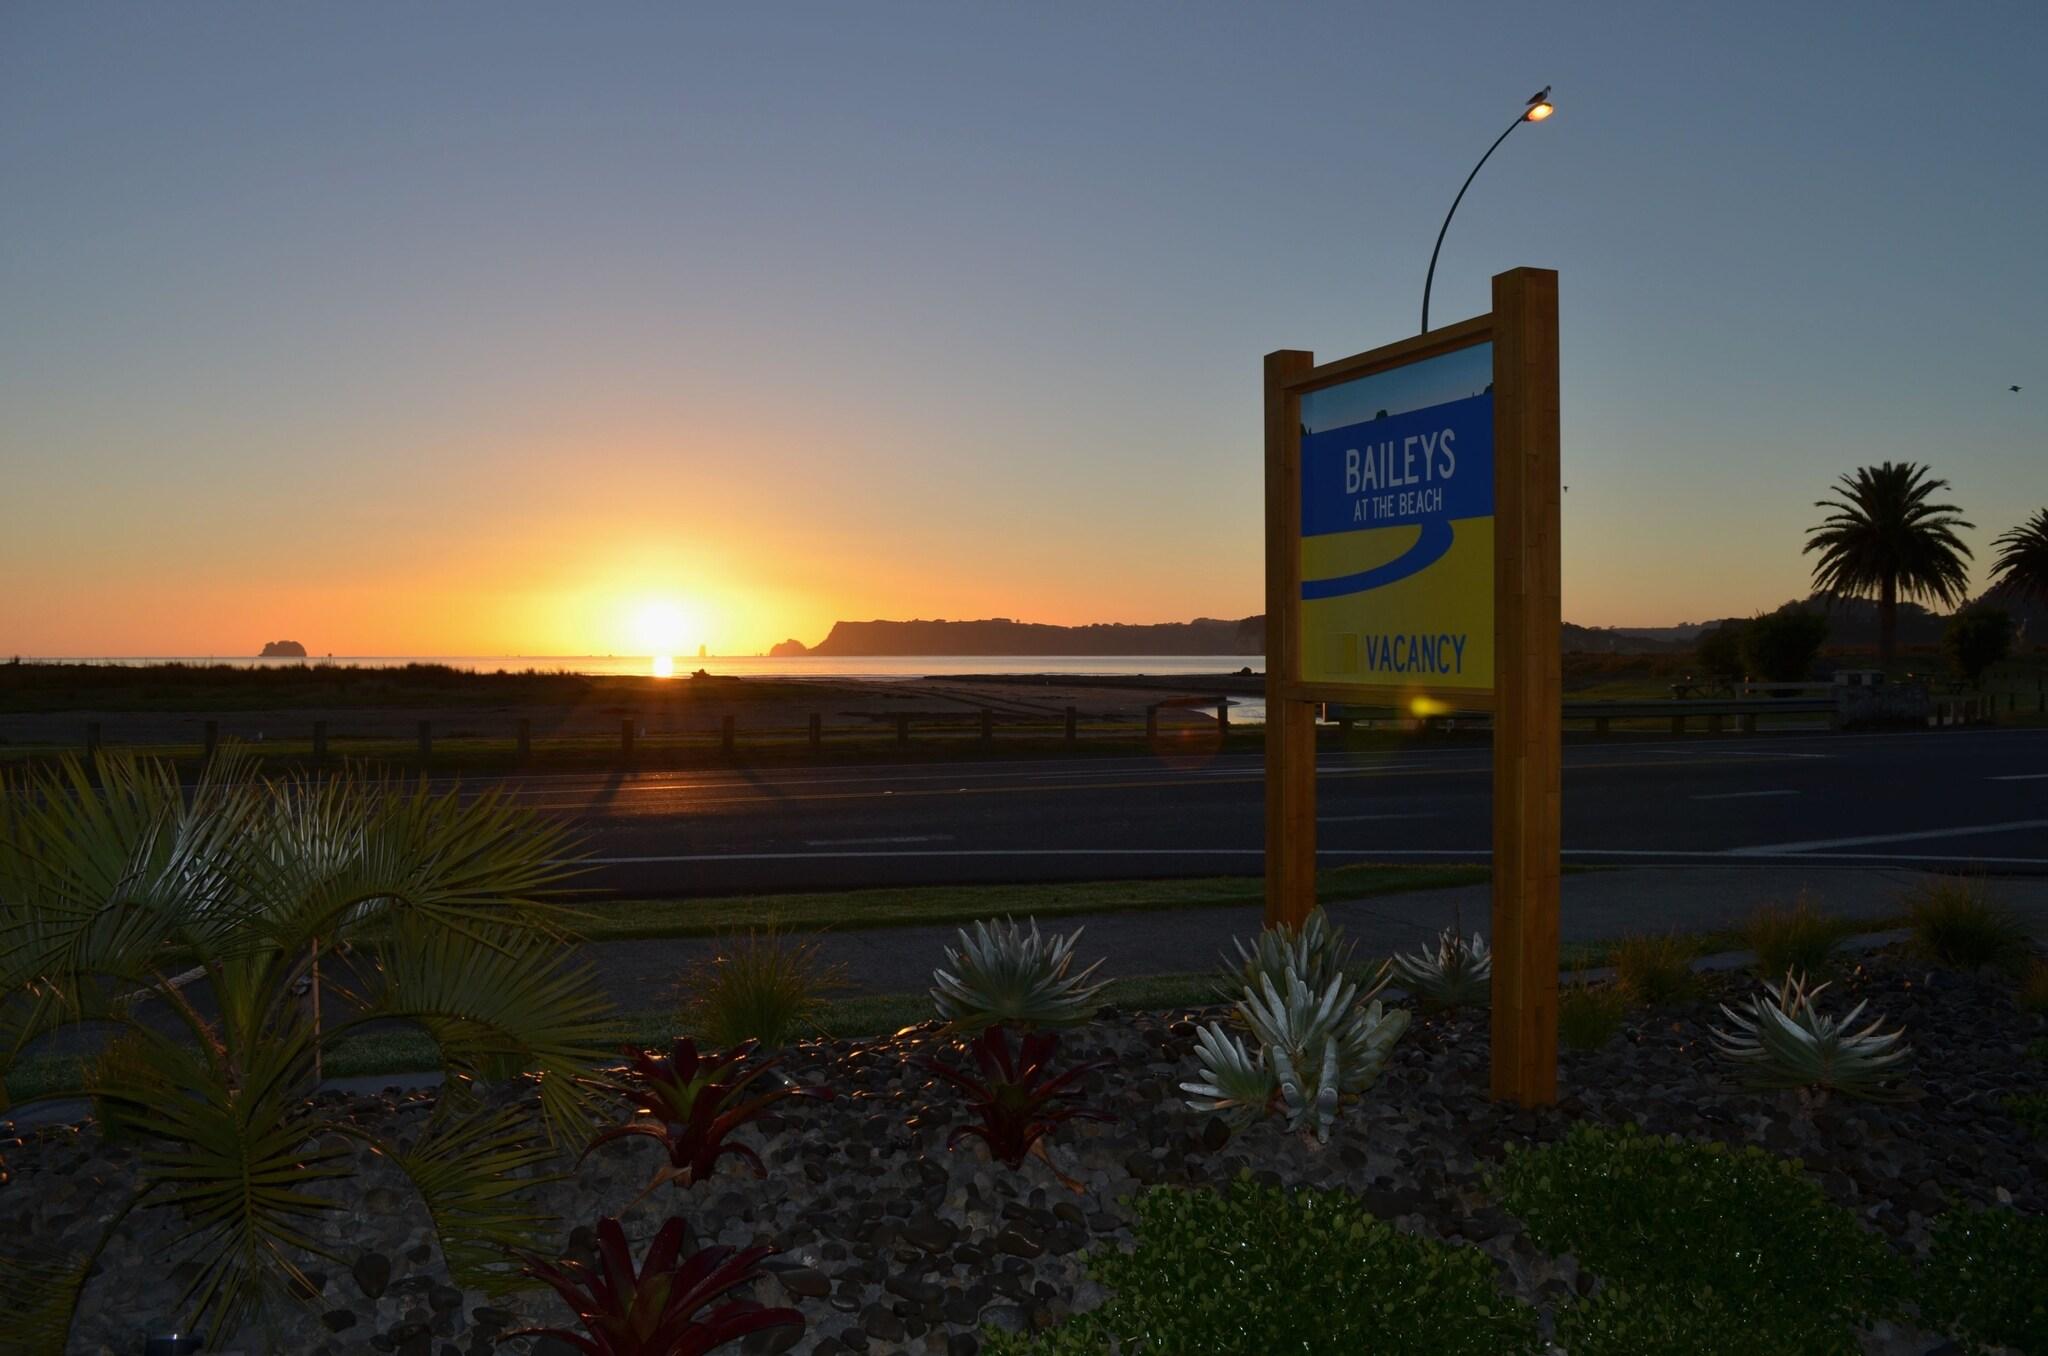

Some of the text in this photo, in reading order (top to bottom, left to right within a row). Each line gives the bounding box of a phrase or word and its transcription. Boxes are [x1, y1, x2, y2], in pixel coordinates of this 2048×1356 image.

[1345, 428, 1456, 494] BAILEYS
[1353, 488, 1442, 522] AT THE BEACH
[1366, 634, 1466, 674] VACANCY
